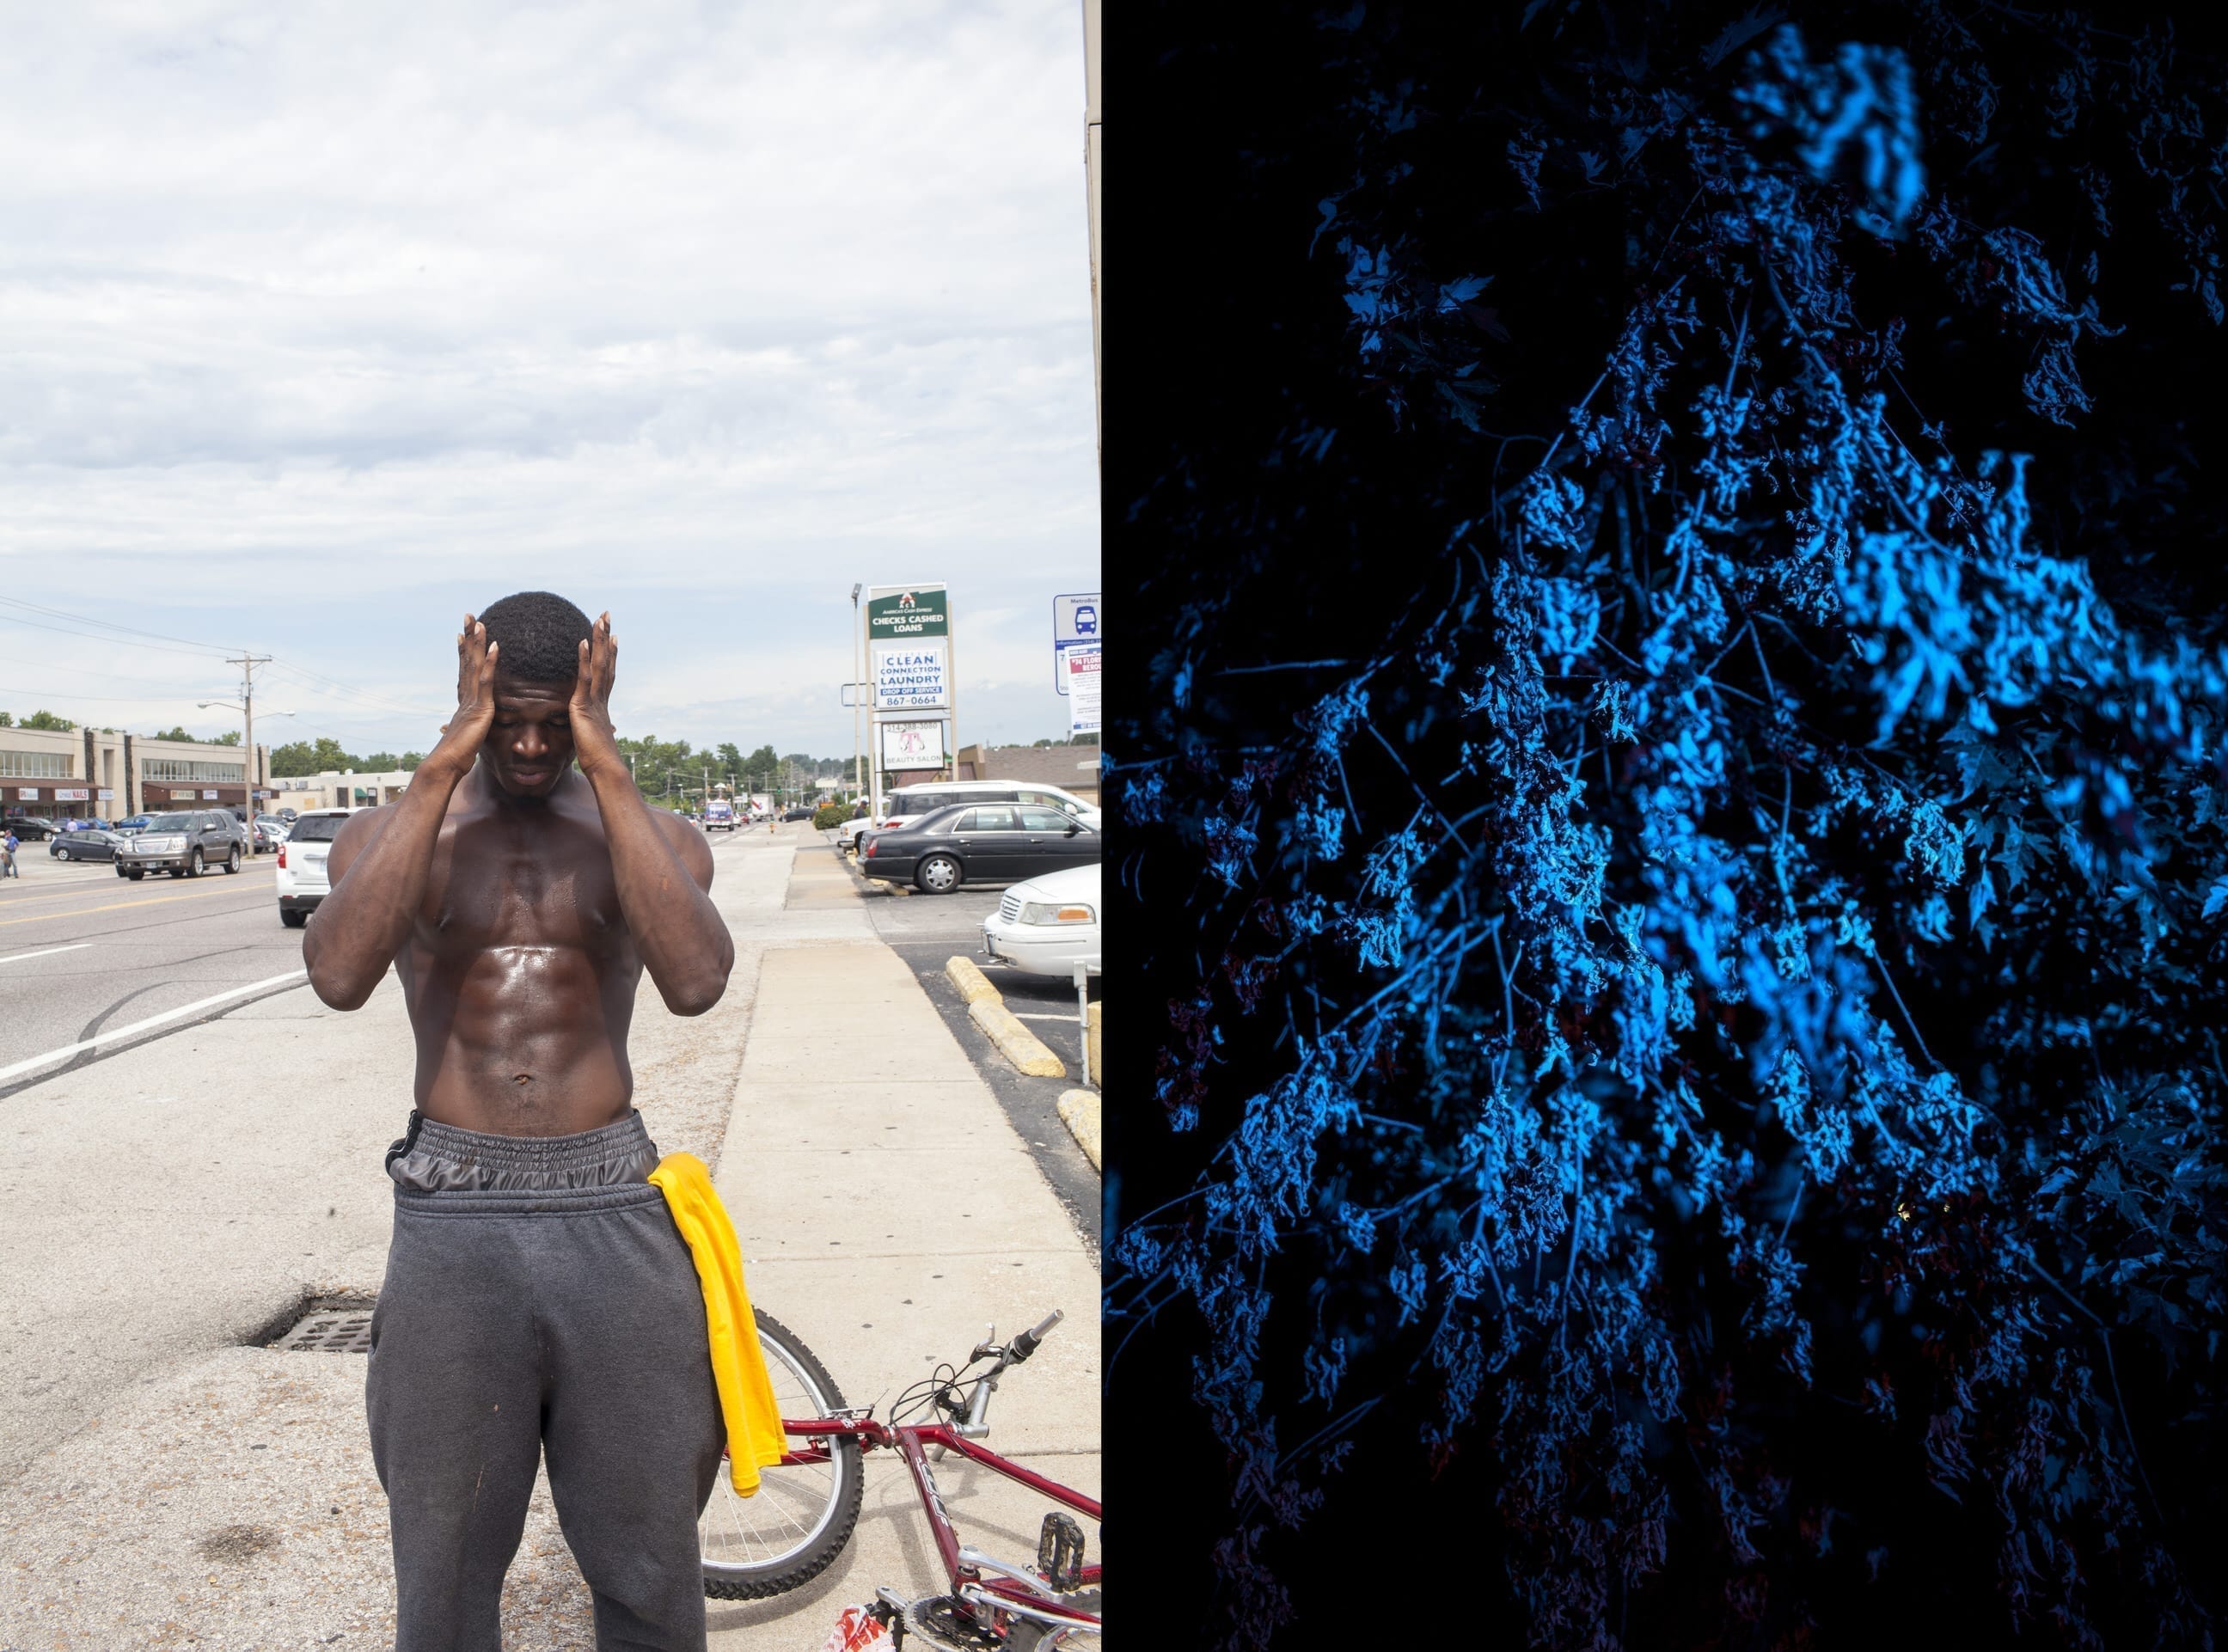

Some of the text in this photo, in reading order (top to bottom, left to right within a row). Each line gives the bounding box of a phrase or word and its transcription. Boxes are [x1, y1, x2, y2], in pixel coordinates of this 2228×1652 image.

[872, 615, 944, 625] CHECKS CASHED
[893, 624, 923, 633] LOANS
[886, 655, 933, 665] CLEAN
[880, 666, 941, 675] CONNECTION
[880, 676, 940, 685] LAUNDRY
[886, 695, 936, 706] 867-0664
[886, 756, 915, 764] BEAUTY
